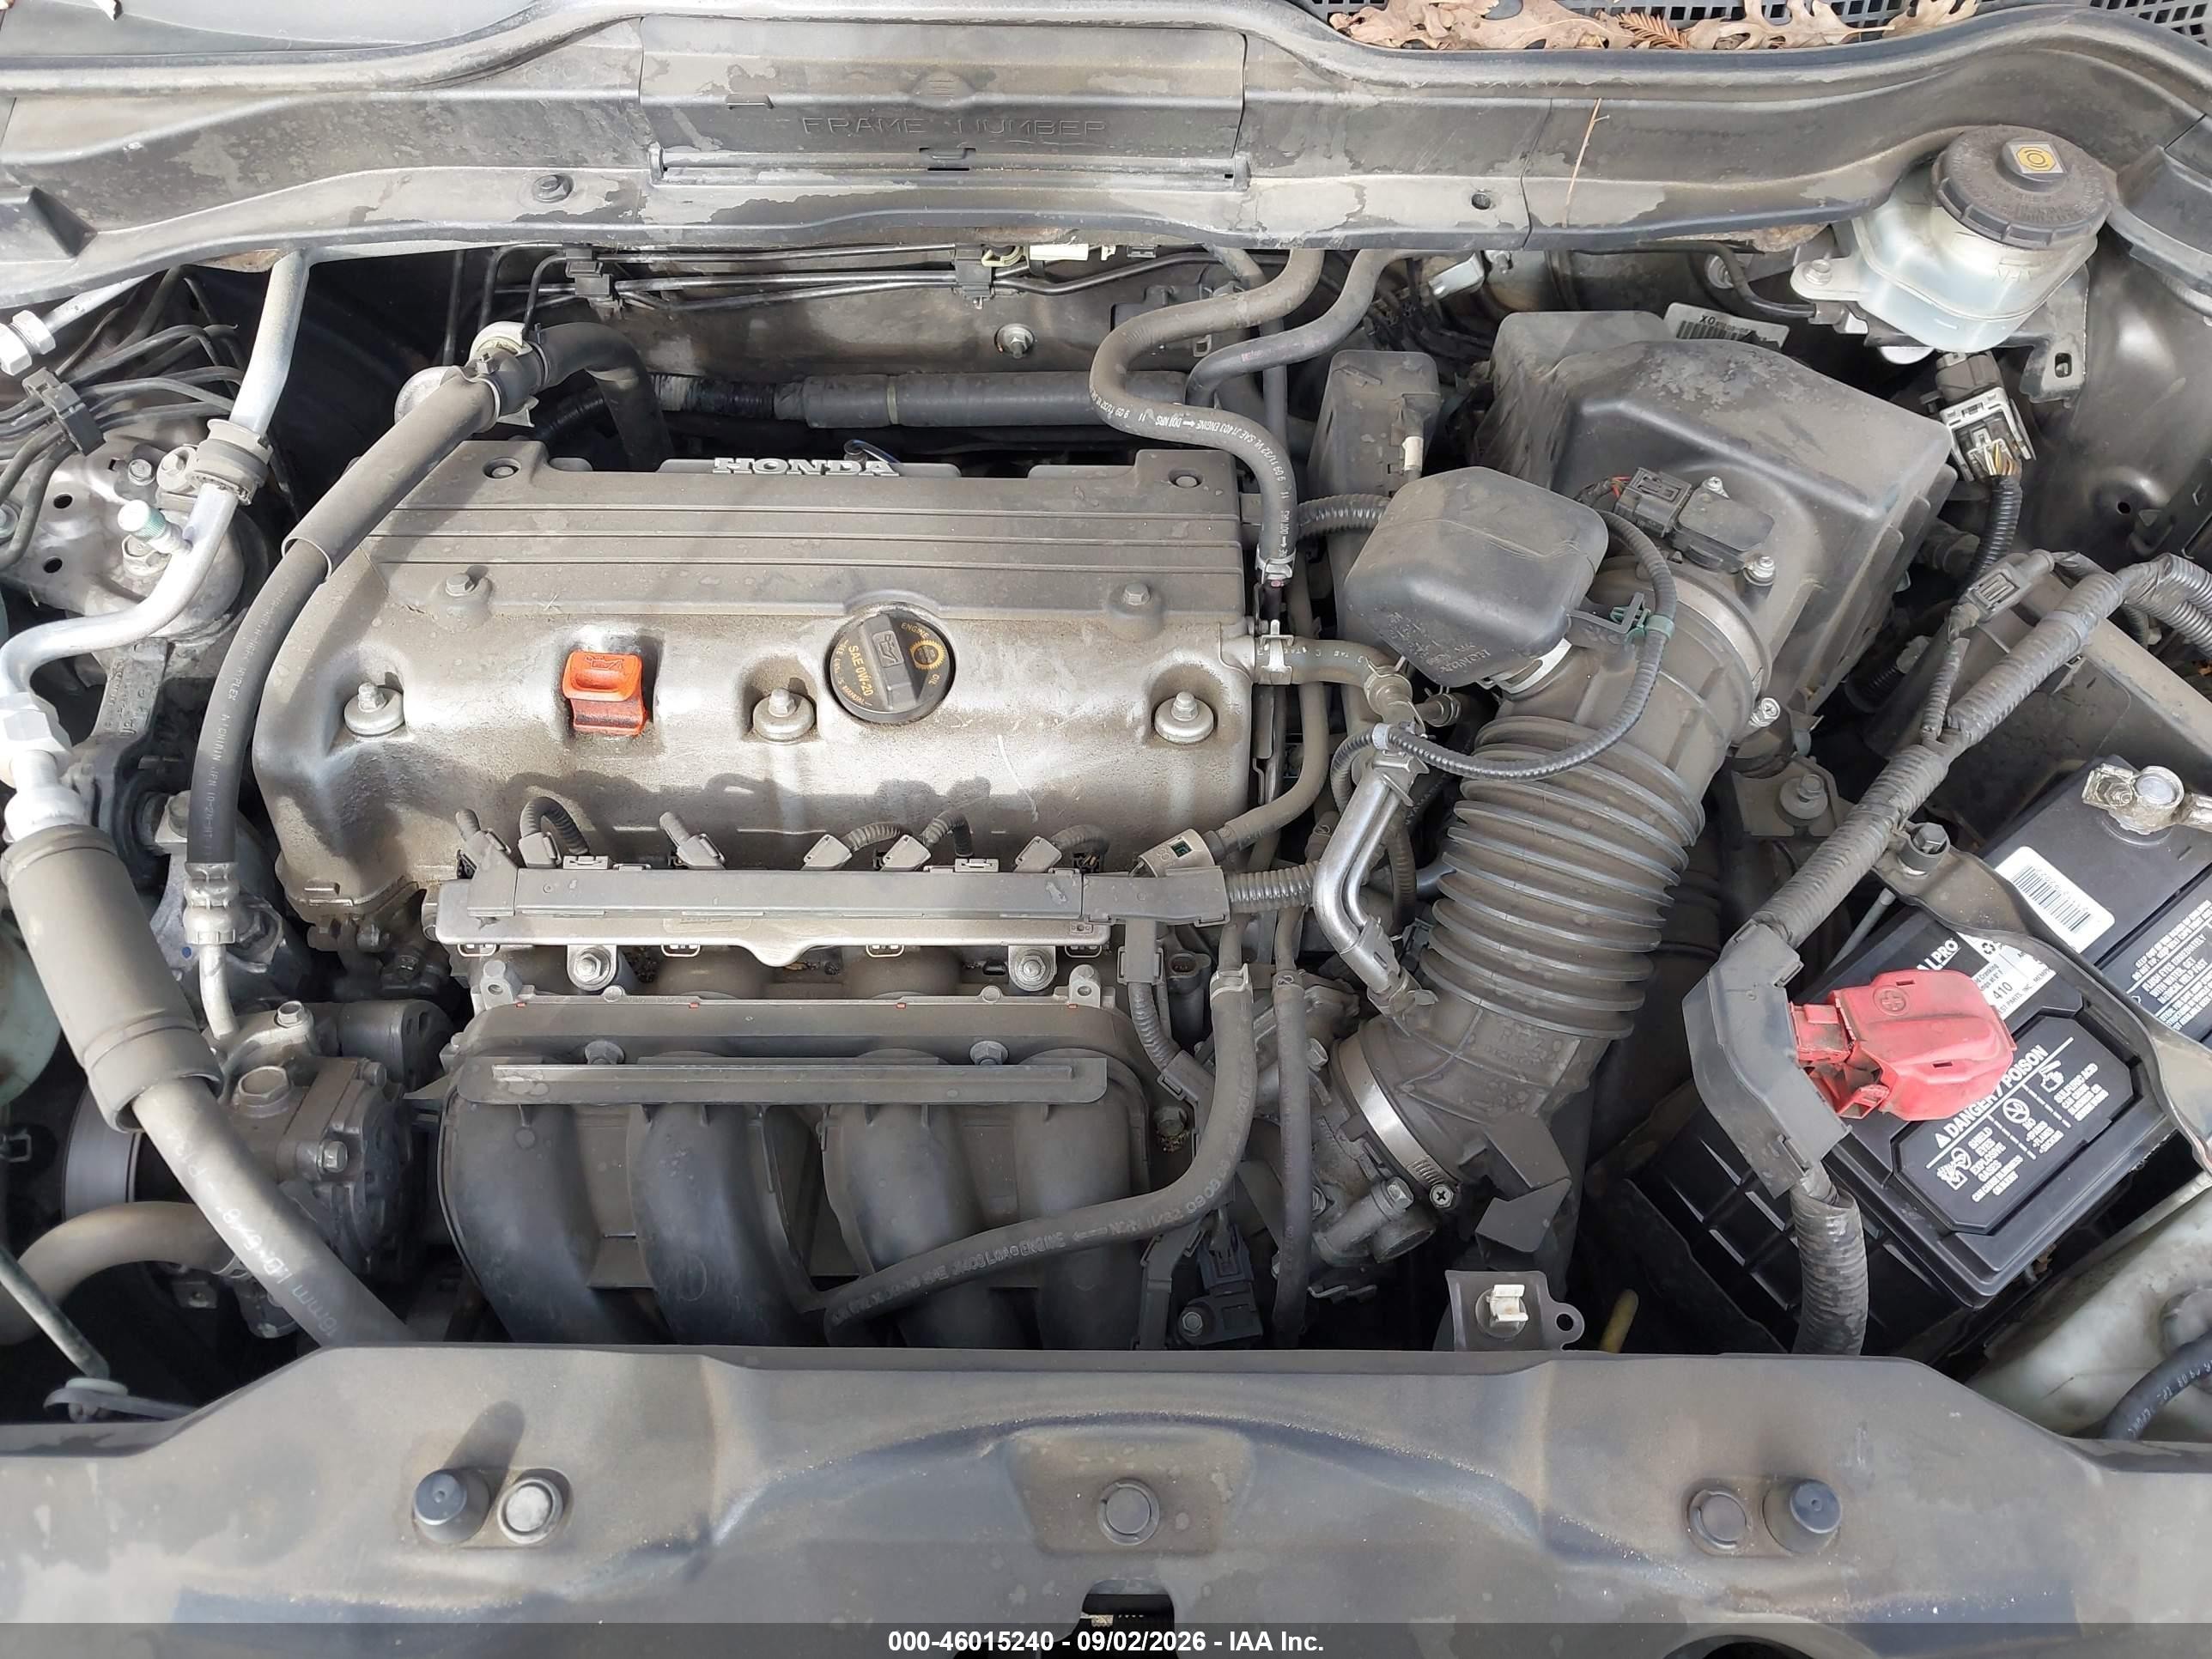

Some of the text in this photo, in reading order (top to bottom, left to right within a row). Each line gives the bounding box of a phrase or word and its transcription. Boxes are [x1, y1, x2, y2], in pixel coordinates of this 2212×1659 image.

[1240, 430, 1256, 442] SAE
[713, 457, 899, 477] HONDA
[901, 623, 930, 638] ENGINE
[928, 674, 940, 686] OIL
[848, 645, 874, 696] SAE 0W-20
[228, 665, 246, 701] HYPLEX
[2142, 973, 2163, 992] FLUSH
[2158, 961, 2176, 978] EYES
[2191, 958, 2209, 975] FAST
[1991, 980, 2014, 1001] 410
[2149, 981, 2167, 1000] WITH
[2002, 1044, 2049, 1089] POISON
[2022, 1116, 2037, 1132] NO
[1969, 1141, 2007, 1176] EXPLOSIVE
[1975, 1137, 1996, 1158] EYES
[1977, 1158, 2003, 1183] GASES
